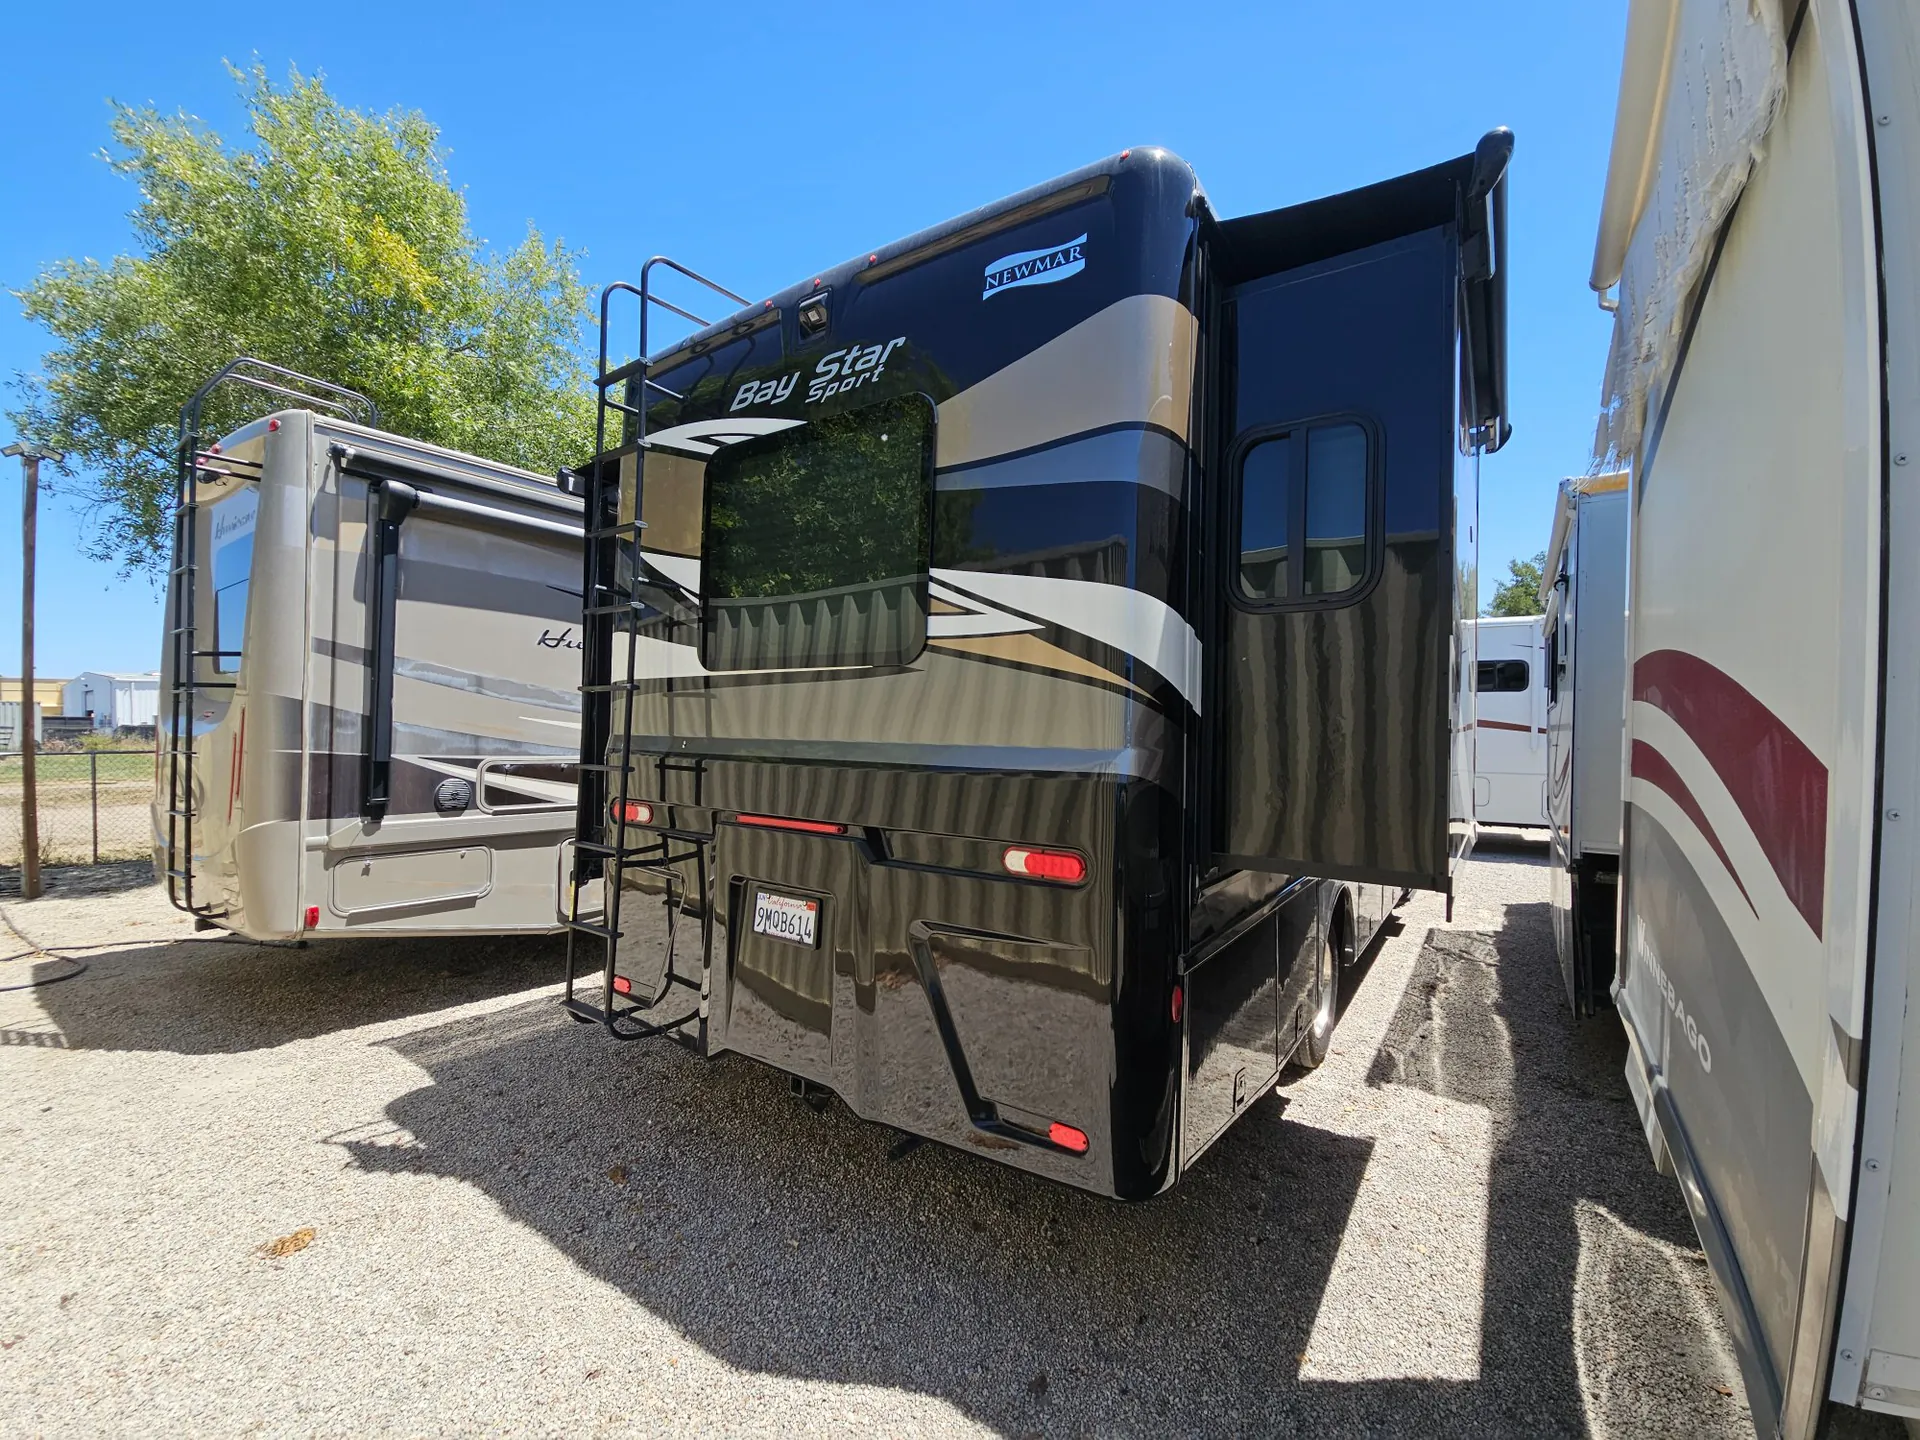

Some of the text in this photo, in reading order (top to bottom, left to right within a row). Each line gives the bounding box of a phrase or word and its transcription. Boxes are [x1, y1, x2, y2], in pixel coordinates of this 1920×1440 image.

[985, 246, 1084, 290] NEWMAR
[729, 336, 907, 413] Bay Star
[805, 364, 885, 403] Sport
[756, 906, 812, 939] 9MQB614
[1636, 914, 1712, 1075] WINNEBAGO
